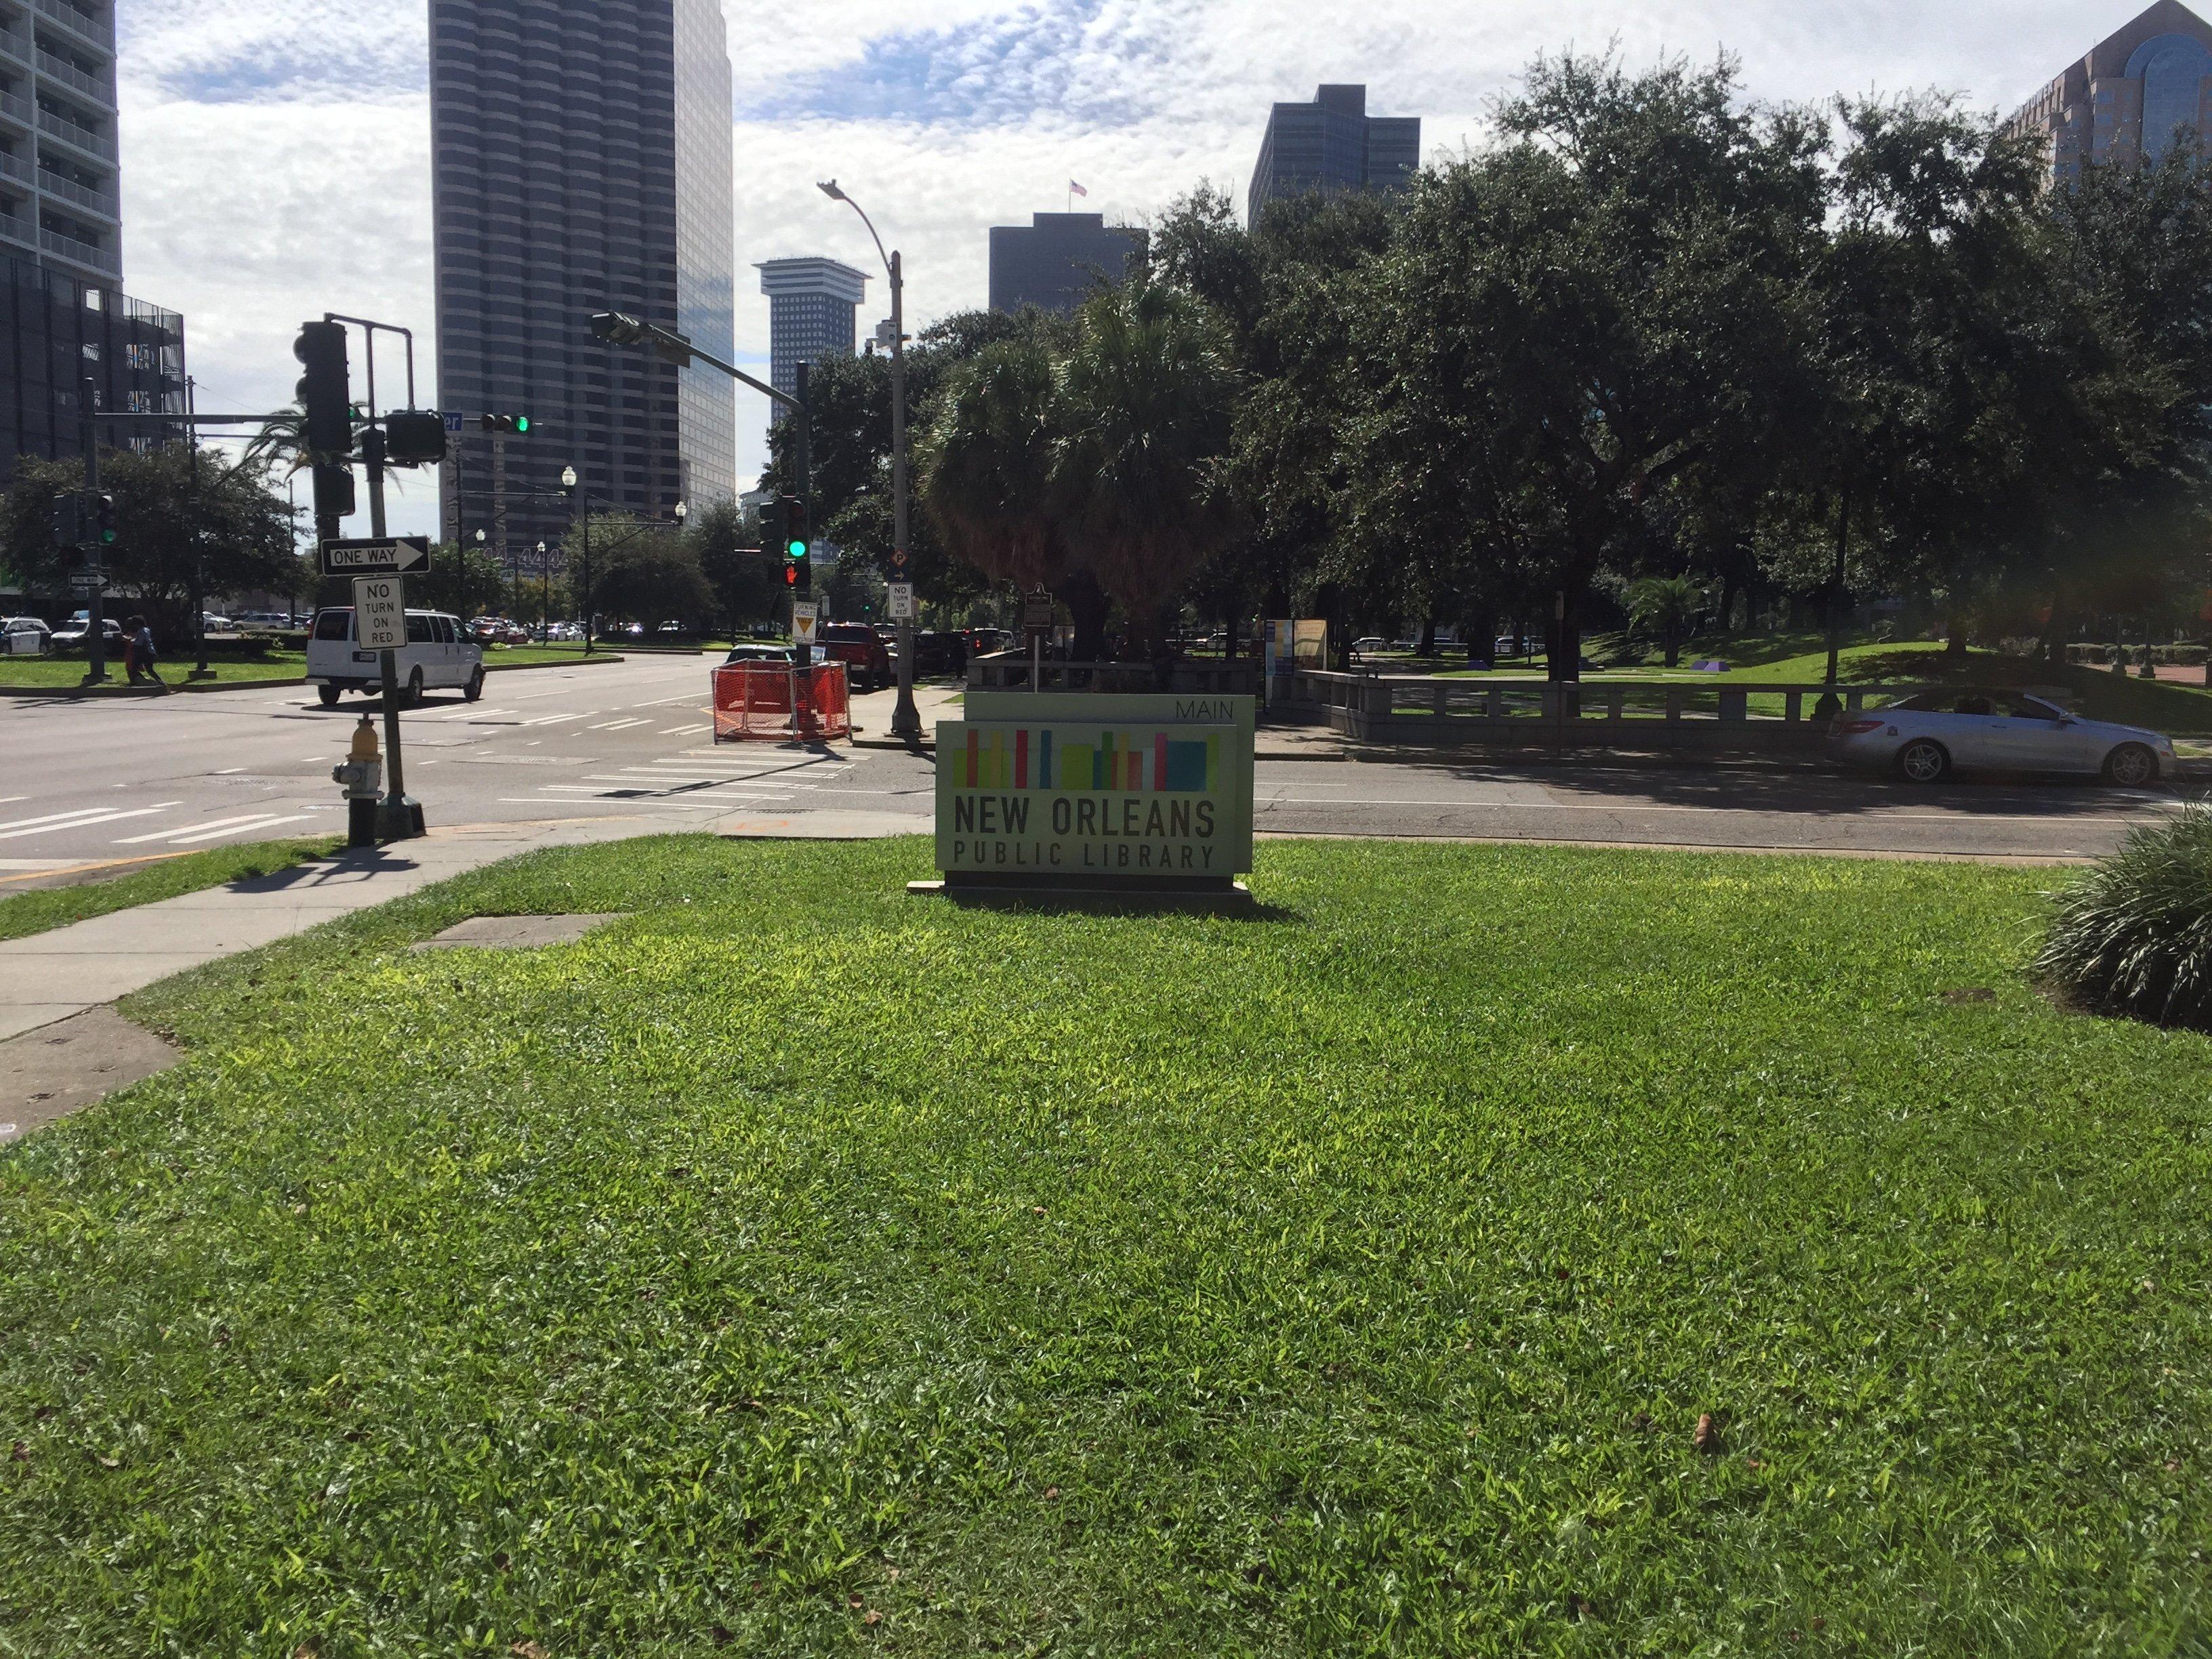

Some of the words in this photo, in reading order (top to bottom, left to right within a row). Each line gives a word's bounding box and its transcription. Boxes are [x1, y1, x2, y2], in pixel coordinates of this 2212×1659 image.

[334, 550, 363, 565] ONE
[367, 549, 396, 563] WAY
[897, 554, 903, 562] P
[367, 583, 390, 598] NO
[365, 602, 394, 614] TURN
[373, 617, 388, 628] ON
[372, 632, 394, 643] RED
[1176, 700, 1233, 719] MAIN
[955, 796, 1029, 834] NEW
[1052, 797, 1214, 838] ORLEANS
[954, 840, 1061, 865] PUBLIC
[1084, 844, 1213, 868] LIBRARY
